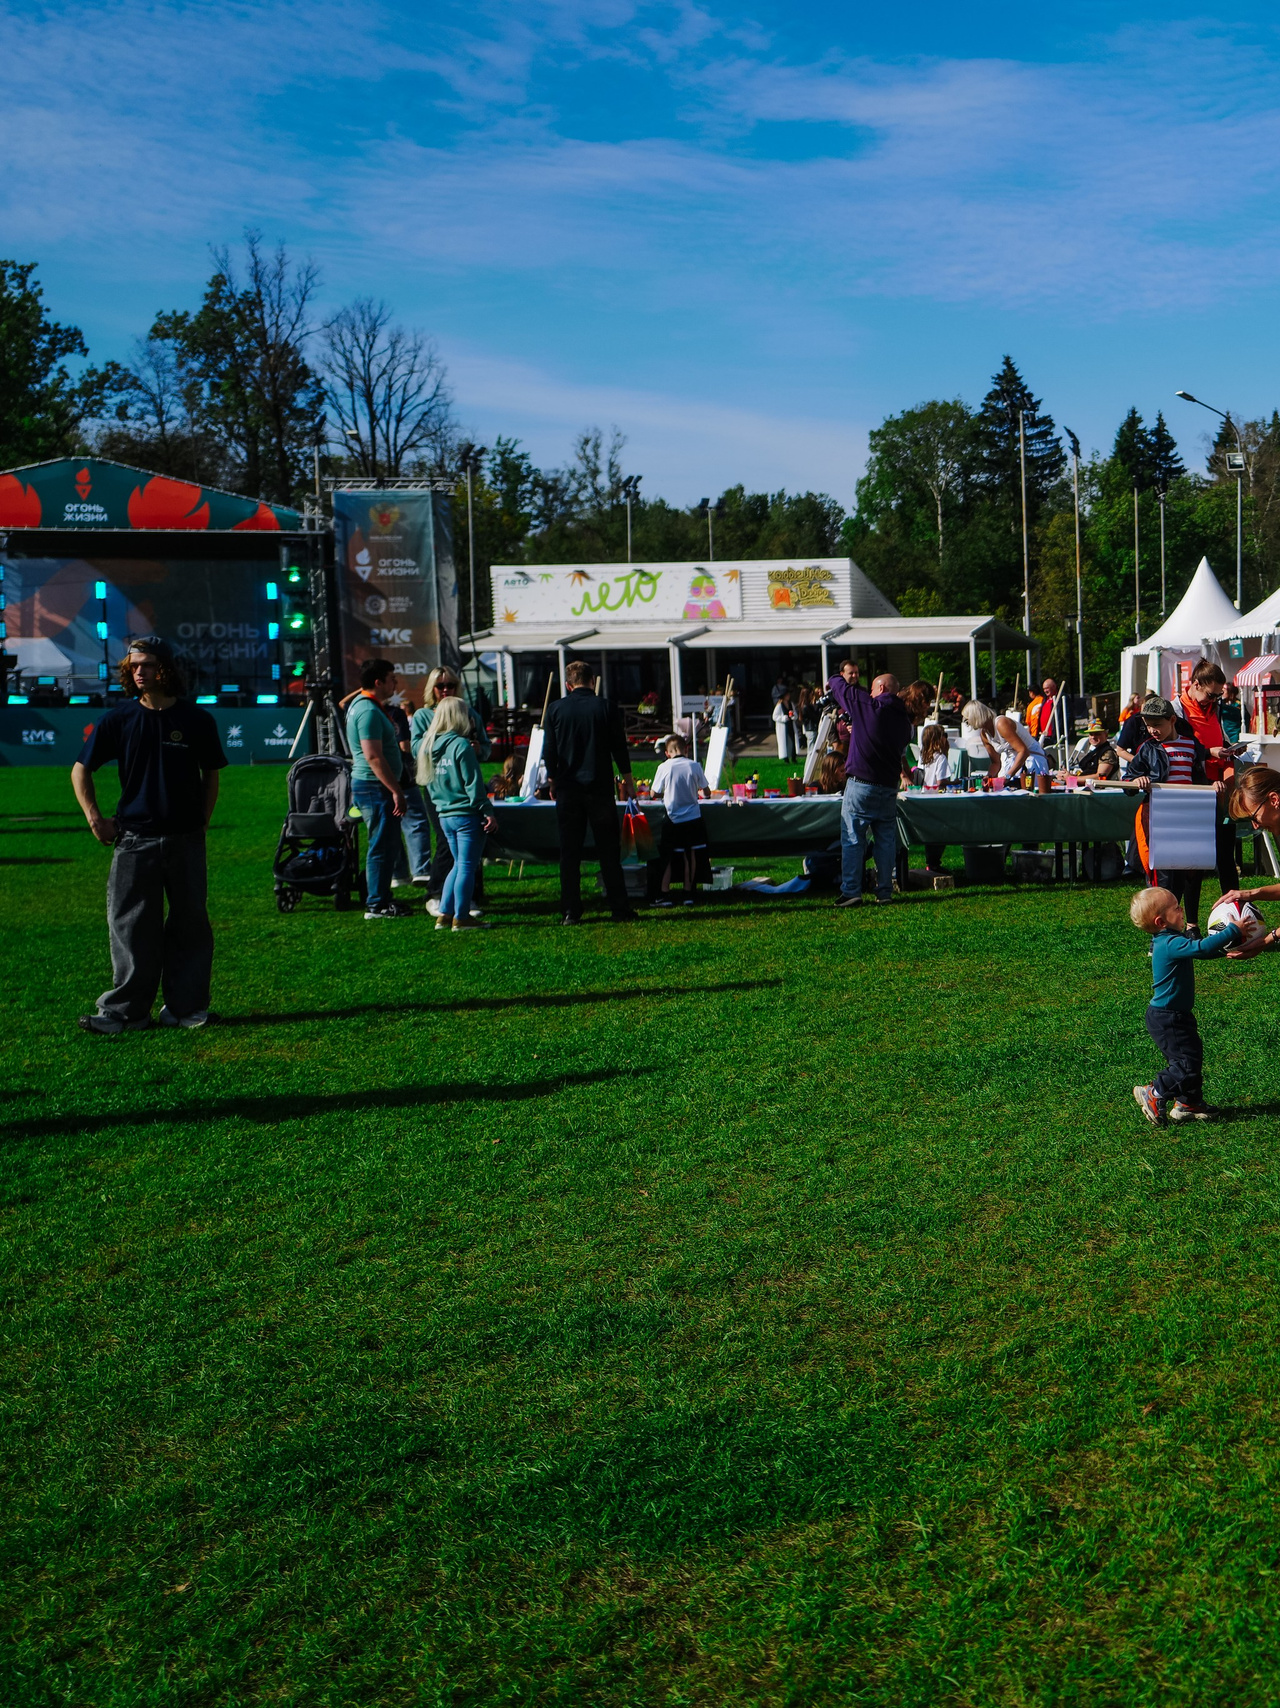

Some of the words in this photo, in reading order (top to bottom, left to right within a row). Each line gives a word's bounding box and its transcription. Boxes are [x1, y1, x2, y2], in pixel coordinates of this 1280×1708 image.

[64, 503, 105, 513] ОГОНЬ
[378, 558, 417, 567] ОГОНЬ
[178, 622, 260, 639] ОГОНЬ
